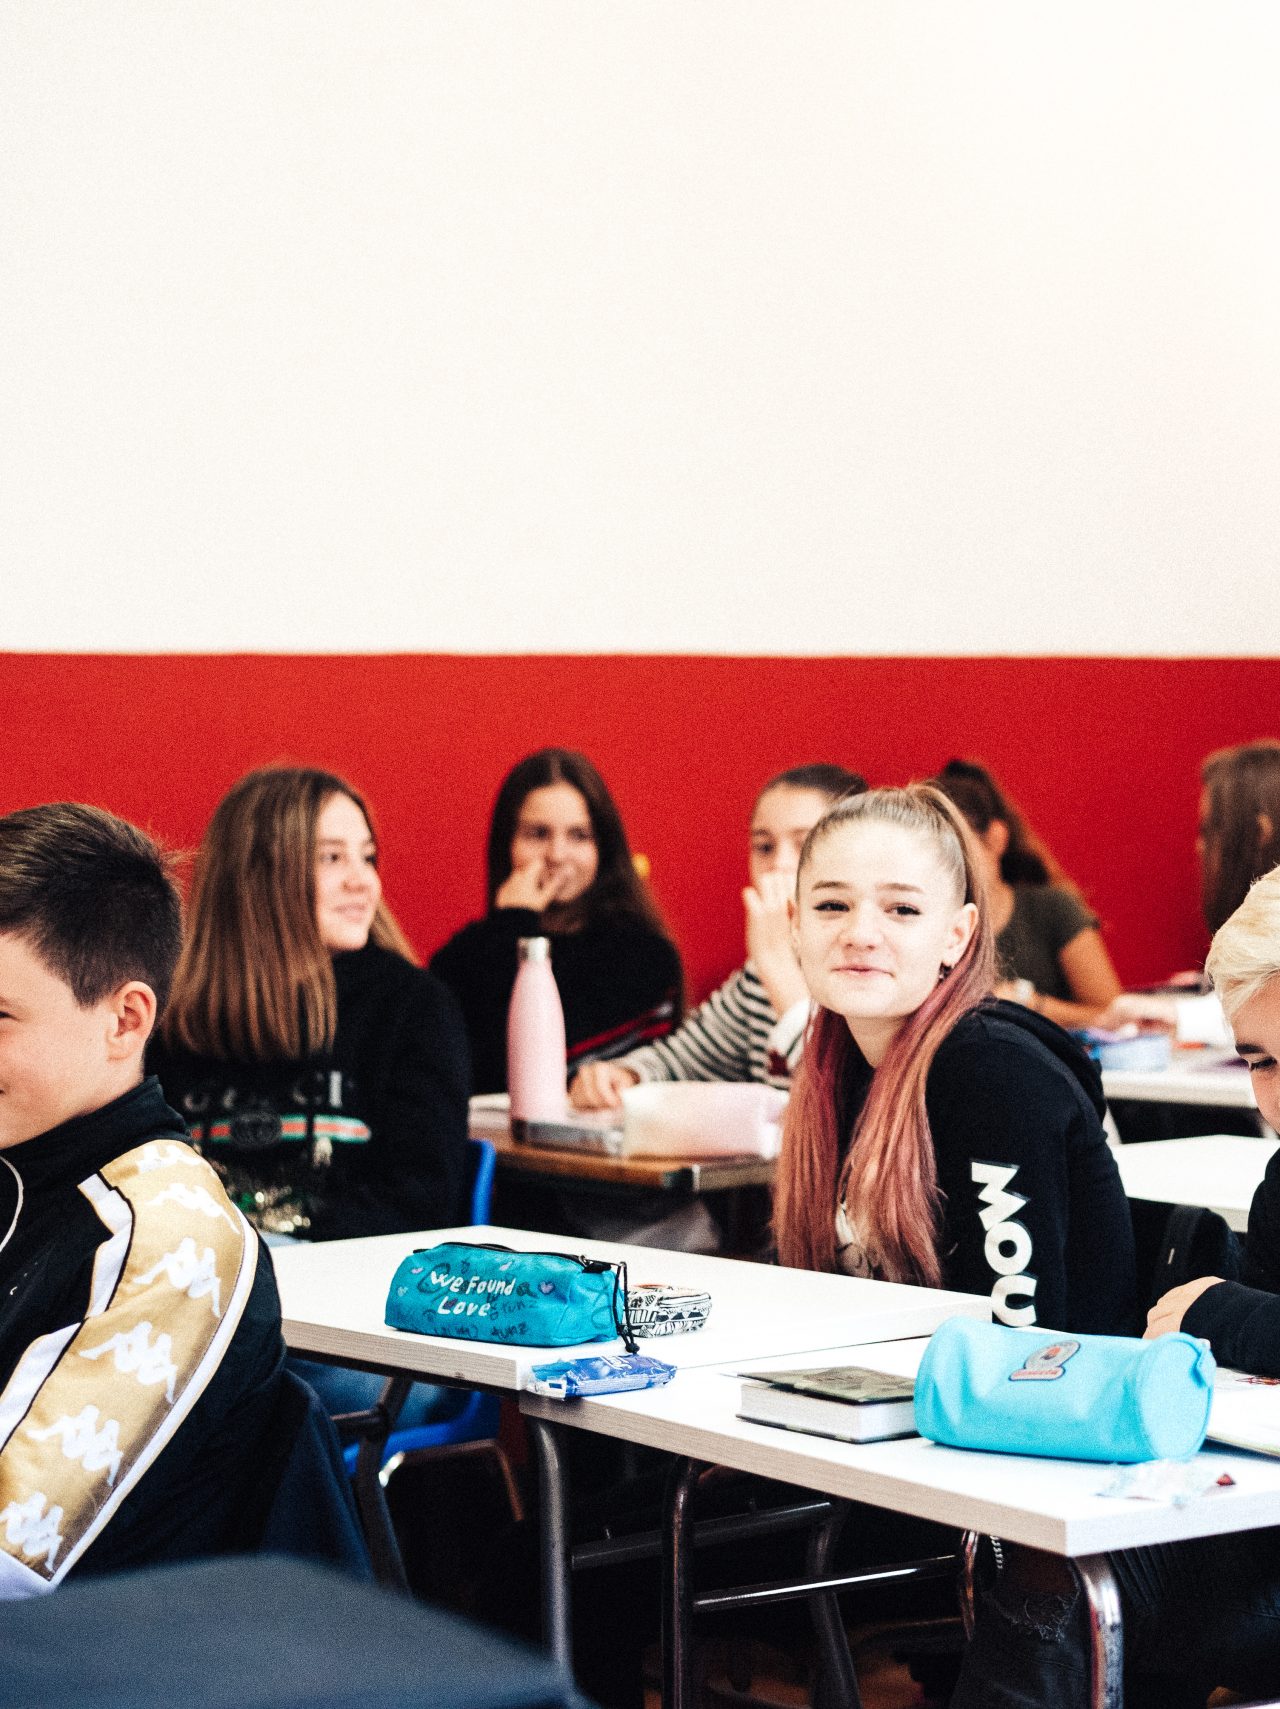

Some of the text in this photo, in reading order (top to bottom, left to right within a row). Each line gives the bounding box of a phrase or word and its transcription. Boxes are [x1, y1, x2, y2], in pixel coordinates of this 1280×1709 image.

[970, 1158, 1038, 1328] MOU
[465, 1275, 517, 1296] Found
[437, 1295, 491, 1317] Love
